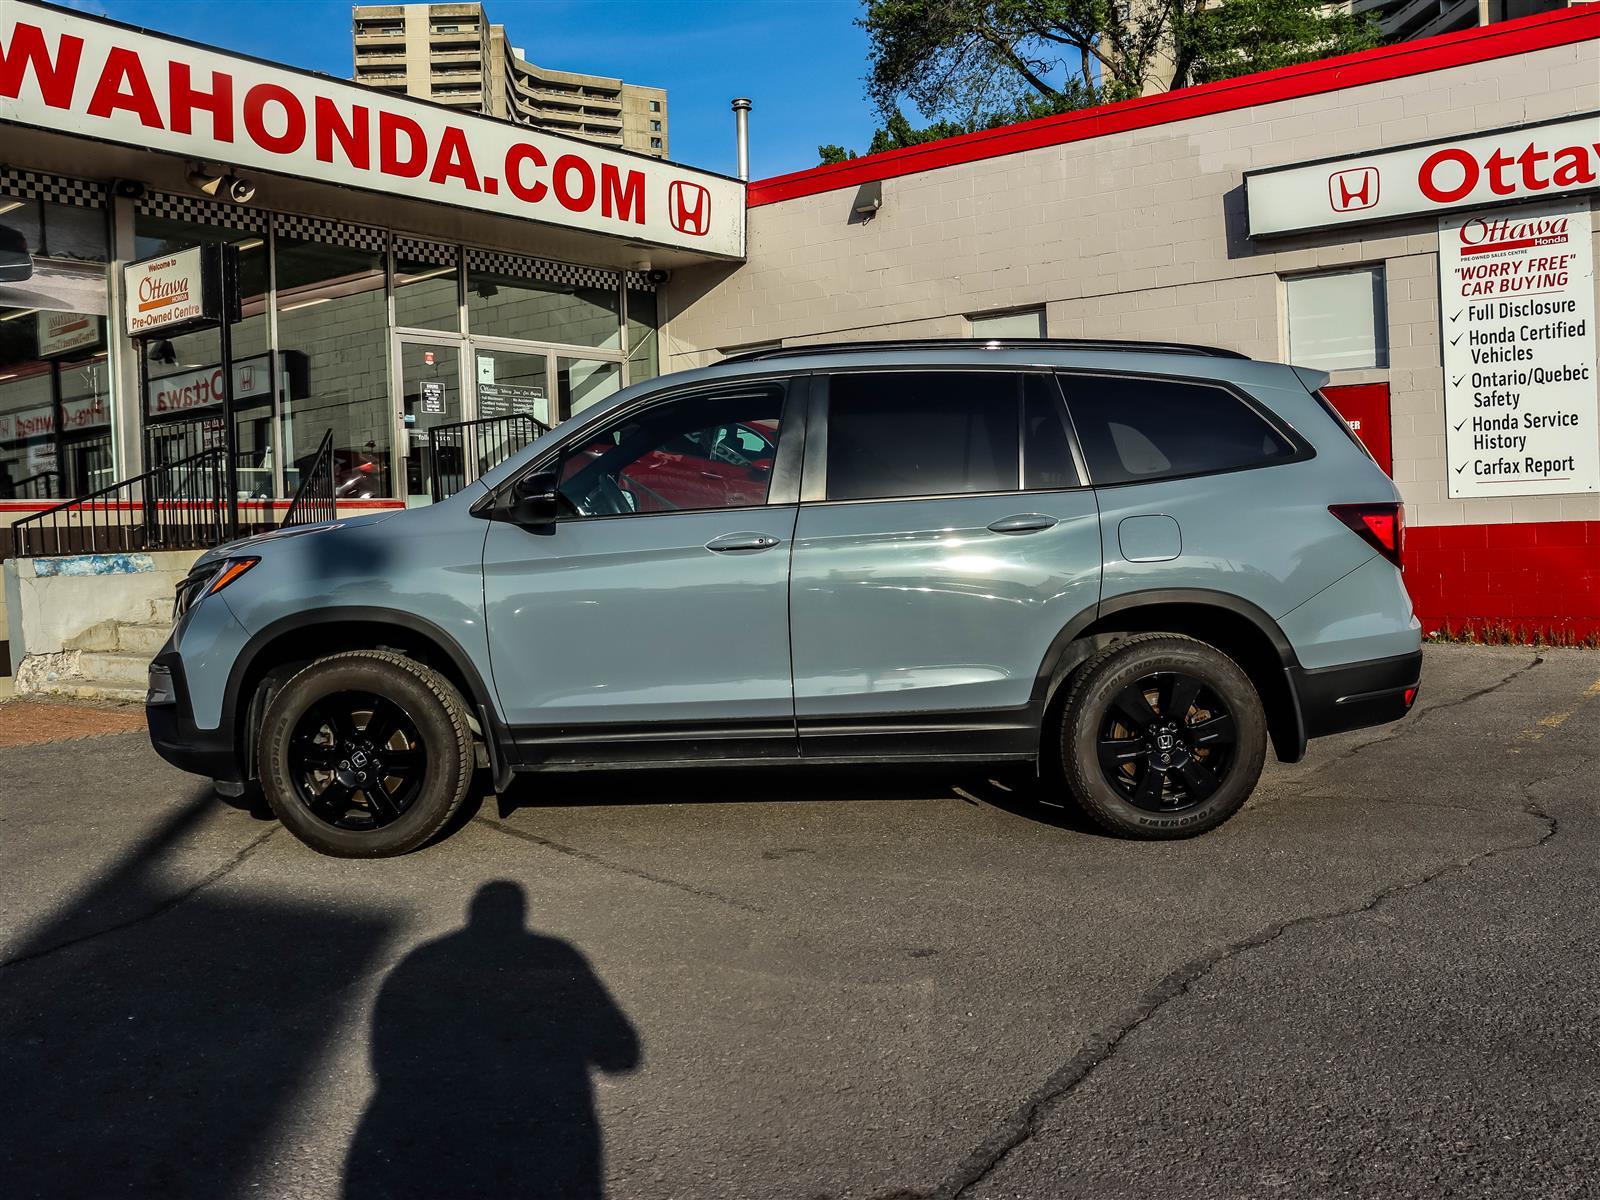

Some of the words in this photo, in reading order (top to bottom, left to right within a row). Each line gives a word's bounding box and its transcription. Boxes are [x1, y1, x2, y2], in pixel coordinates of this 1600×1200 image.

[0, 21, 647, 226] WAHONDA.COM
[1418, 141, 1600, 203] Otta
[1460, 216, 1568, 245] Ottawa
[1534, 235, 1567, 246] Honda
[147, 260, 171, 273] Welcome
[170, 258, 177, 266] to
[1454, 260, 1523, 281] "WORRY
[1527, 253, 1577, 273] FREE"
[1460, 253, 1491, 262] PRE-OWNED
[138, 276, 189, 303] Ottawa
[1461, 280, 1495, 297] CAR
[1499, 271, 1569, 293] BUYING
[132, 309, 172, 329] Pre-Owned
[174, 304, 200, 319] Centre
[1468, 303, 1494, 321] Full
[1499, 299, 1576, 319] Disclosure
[1469, 326, 1516, 346] Honda
[1520, 319, 1586, 341] Certified
[1471, 345, 1534, 364] Vehicles
[1471, 364, 1589, 389] Ontario/Quebec
[1473, 390, 1520, 410] Safety
[1472, 413, 1519, 432] Honda
[1523, 410, 1579, 429] Service
[1473, 434, 1527, 452] History
[1474, 457, 1520, 475] Carfax
[1525, 455, 1575, 477] Report
[1138, 806, 1217, 828] YOKOHAMA
